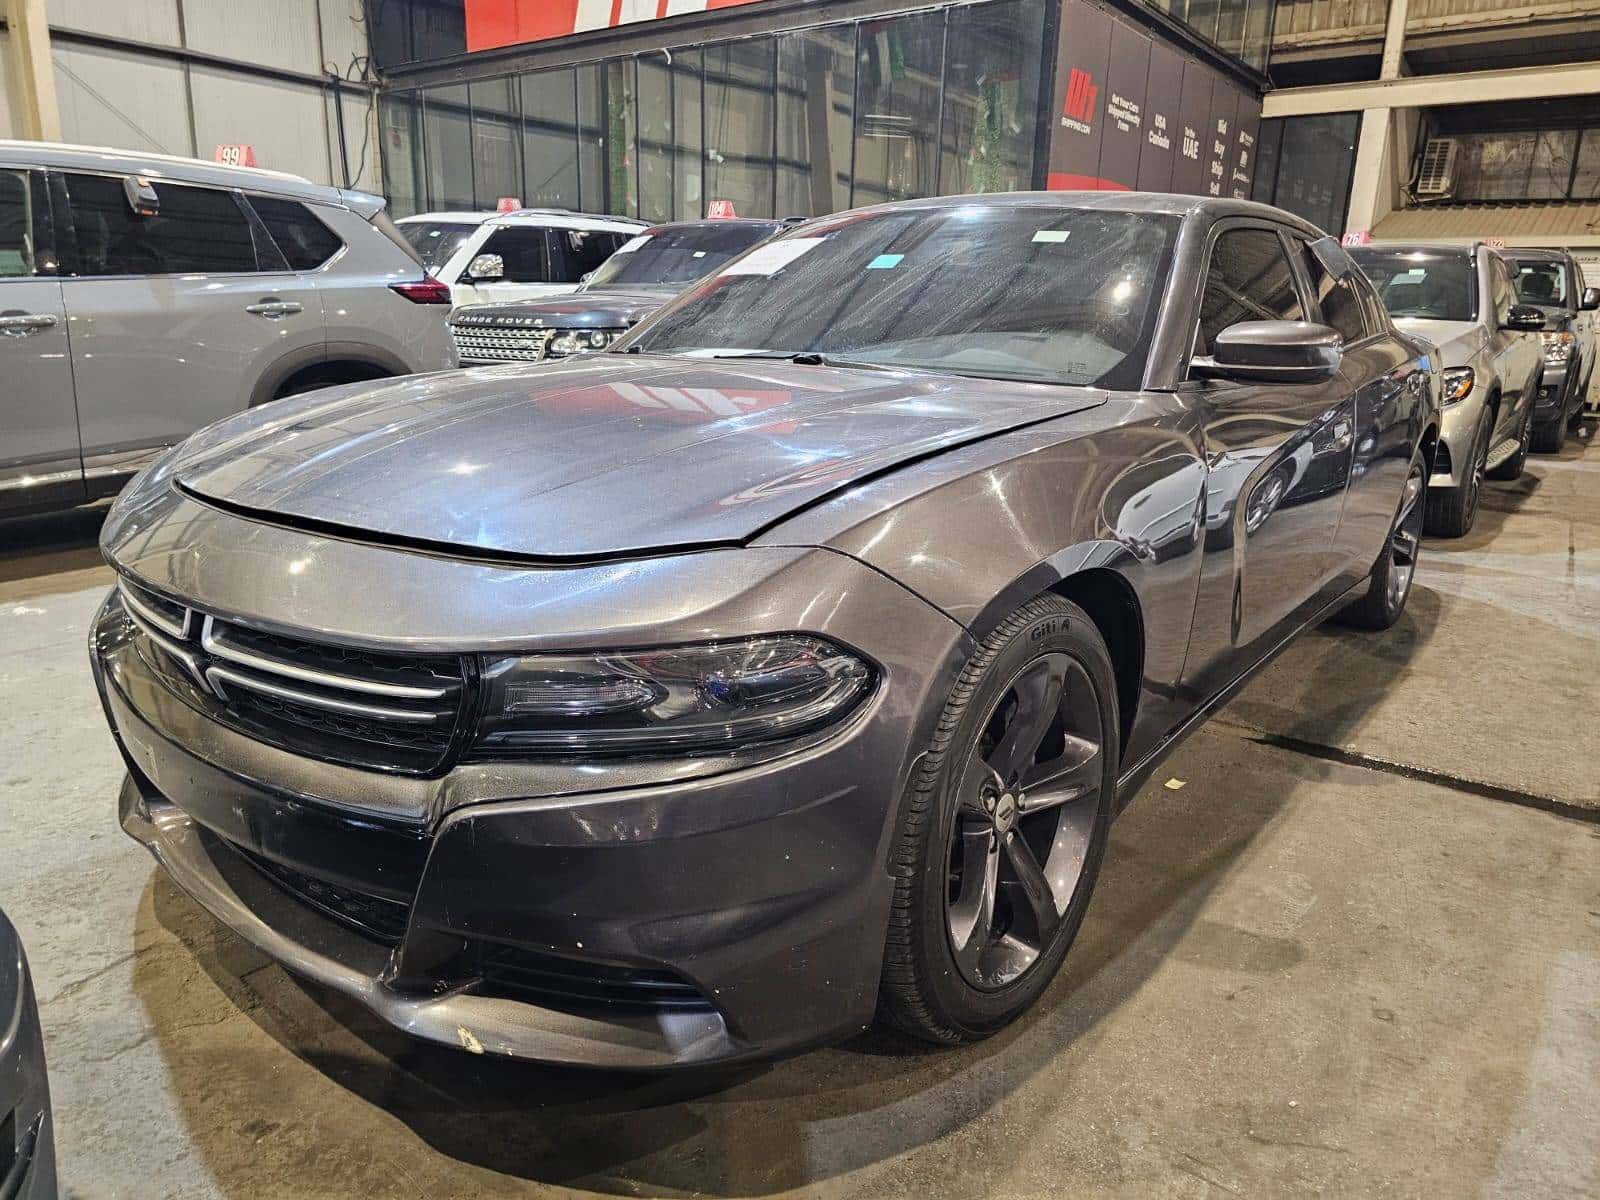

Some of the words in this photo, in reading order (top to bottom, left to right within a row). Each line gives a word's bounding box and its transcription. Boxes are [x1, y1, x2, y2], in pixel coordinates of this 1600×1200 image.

[1155, 113, 1166, 130] USA
[1148, 130, 1170, 150] Canada
[1183, 136, 1199, 160] UAE
[1214, 140, 1226, 160] Buy
[222, 147, 240, 167] 99
[1211, 161, 1223, 180] Ship
[458, 315, 493, 323] RANGE
[497, 317, 544, 325] ROVER
